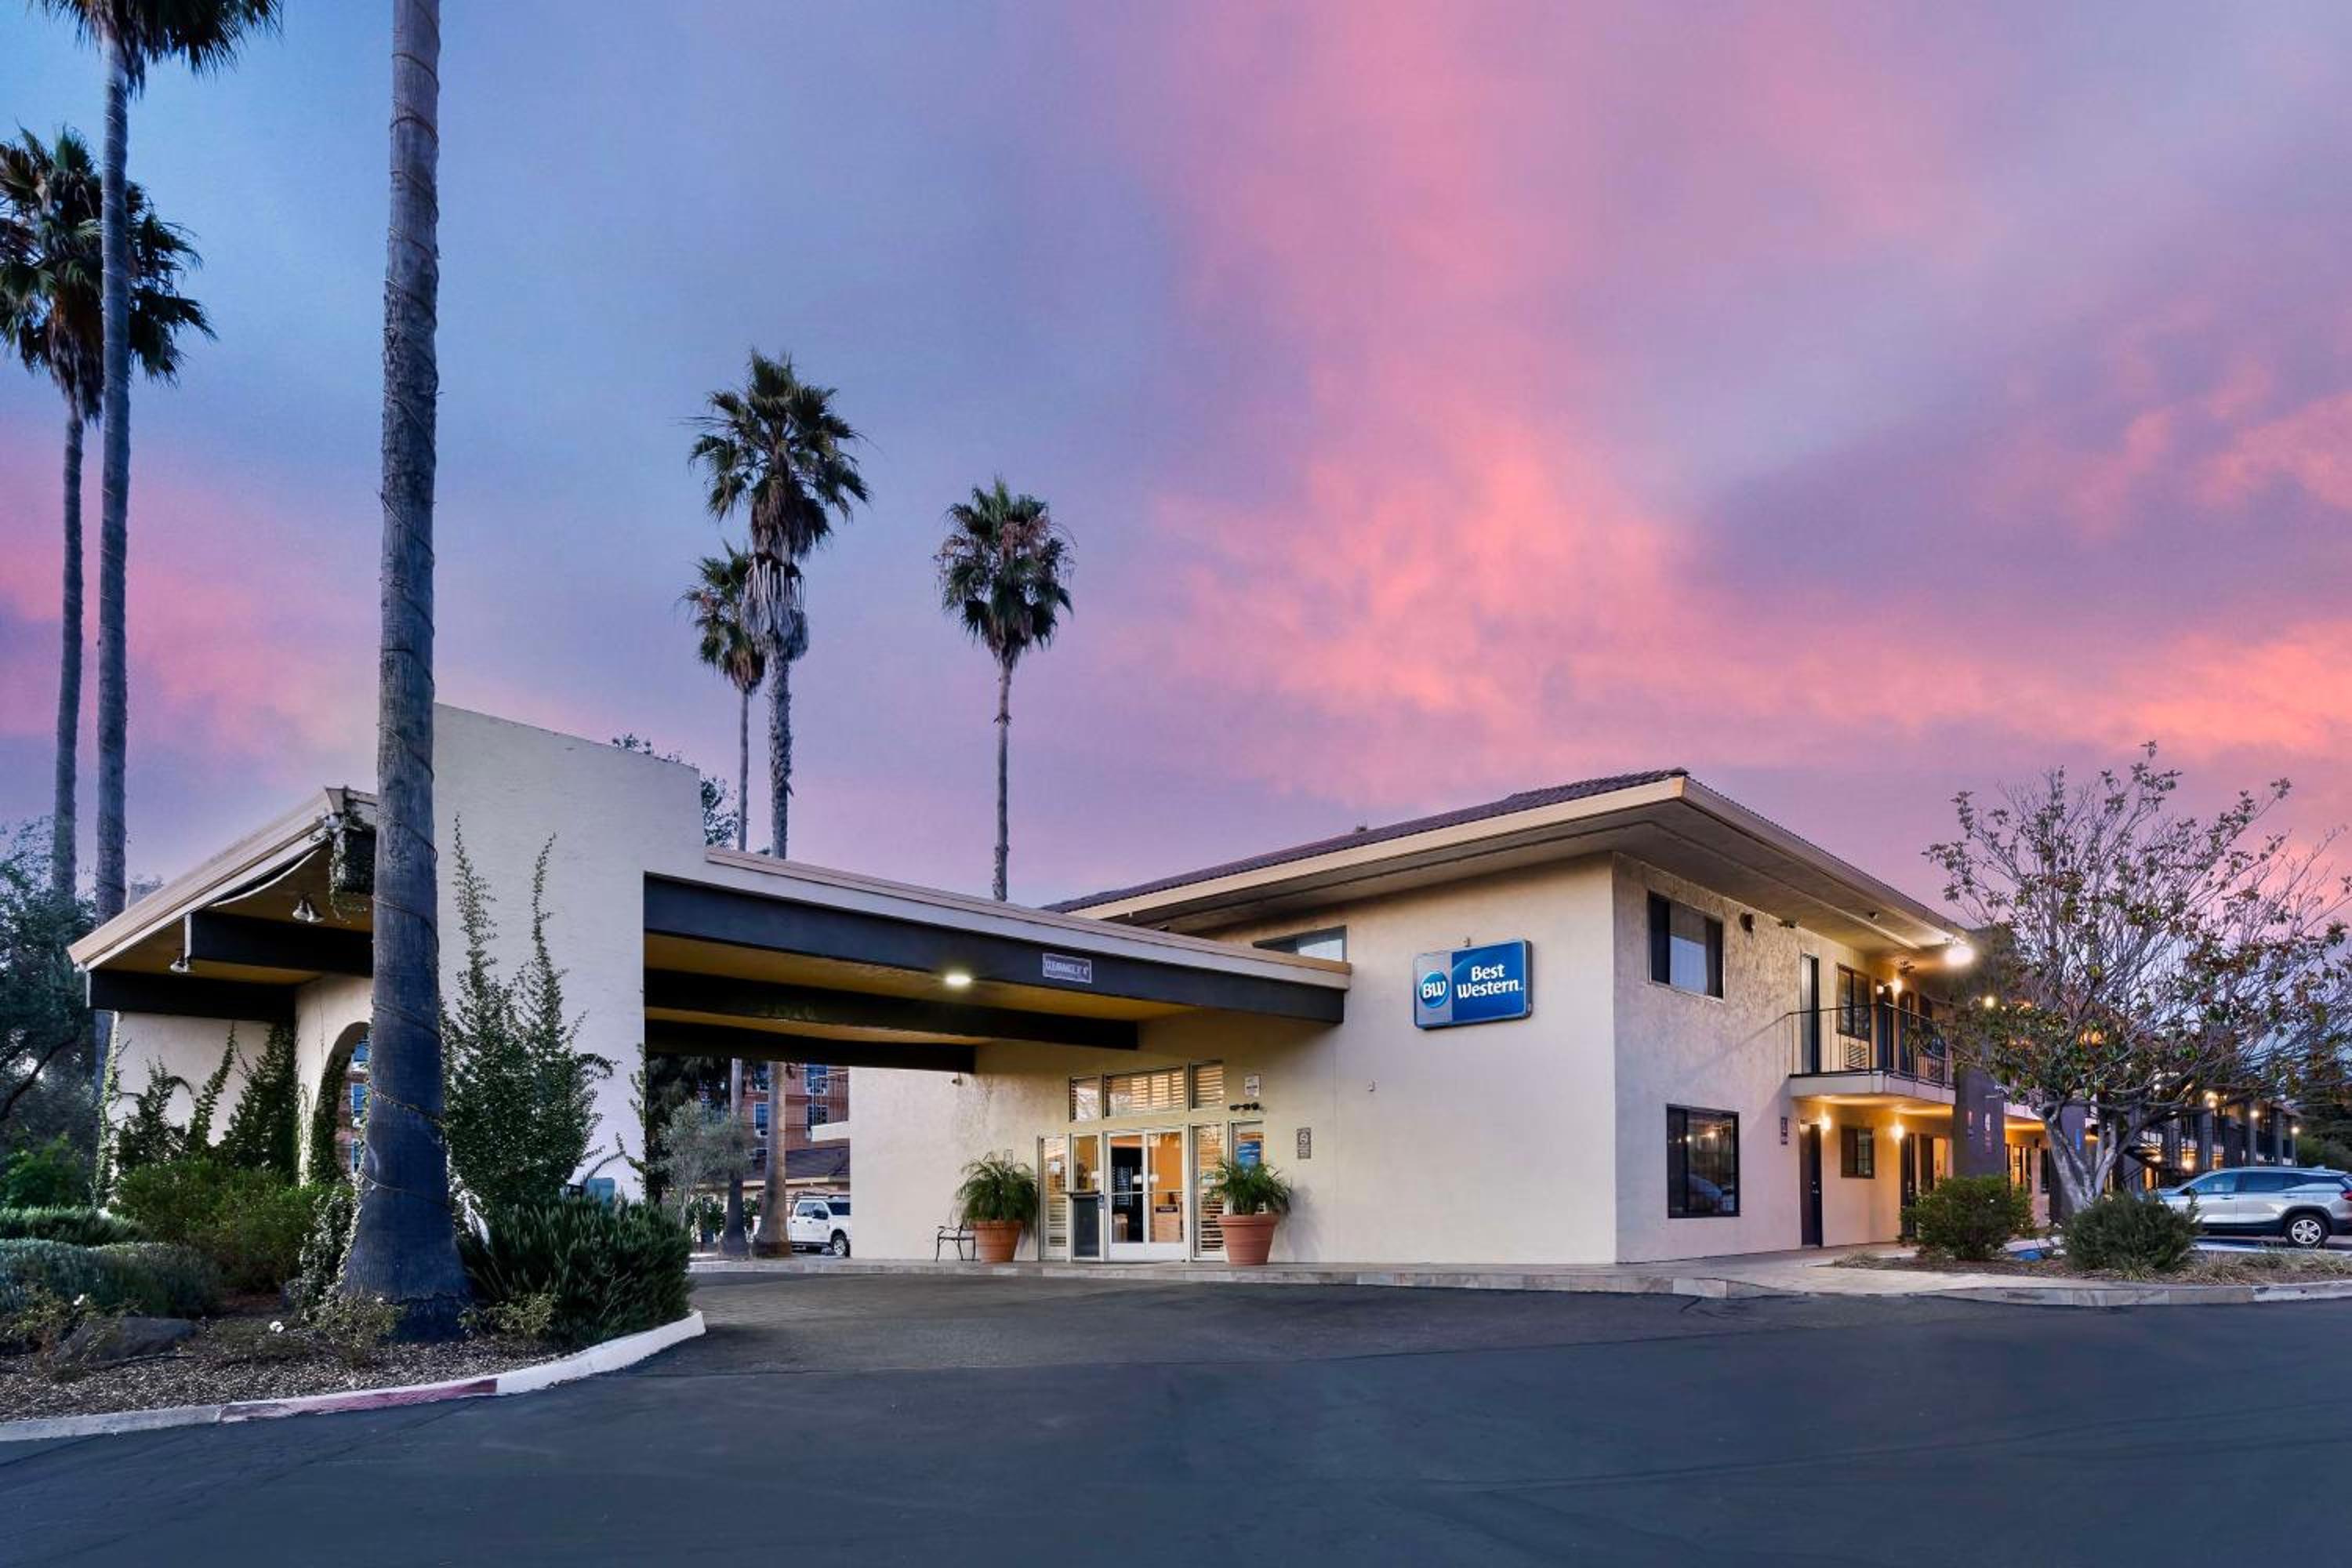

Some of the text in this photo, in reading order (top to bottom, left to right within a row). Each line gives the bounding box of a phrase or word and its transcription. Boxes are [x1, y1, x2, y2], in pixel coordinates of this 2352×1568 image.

[1472, 964, 1505, 982] Best
[1422, 981, 1446, 999] BW
[1457, 978, 1519, 999] Western
